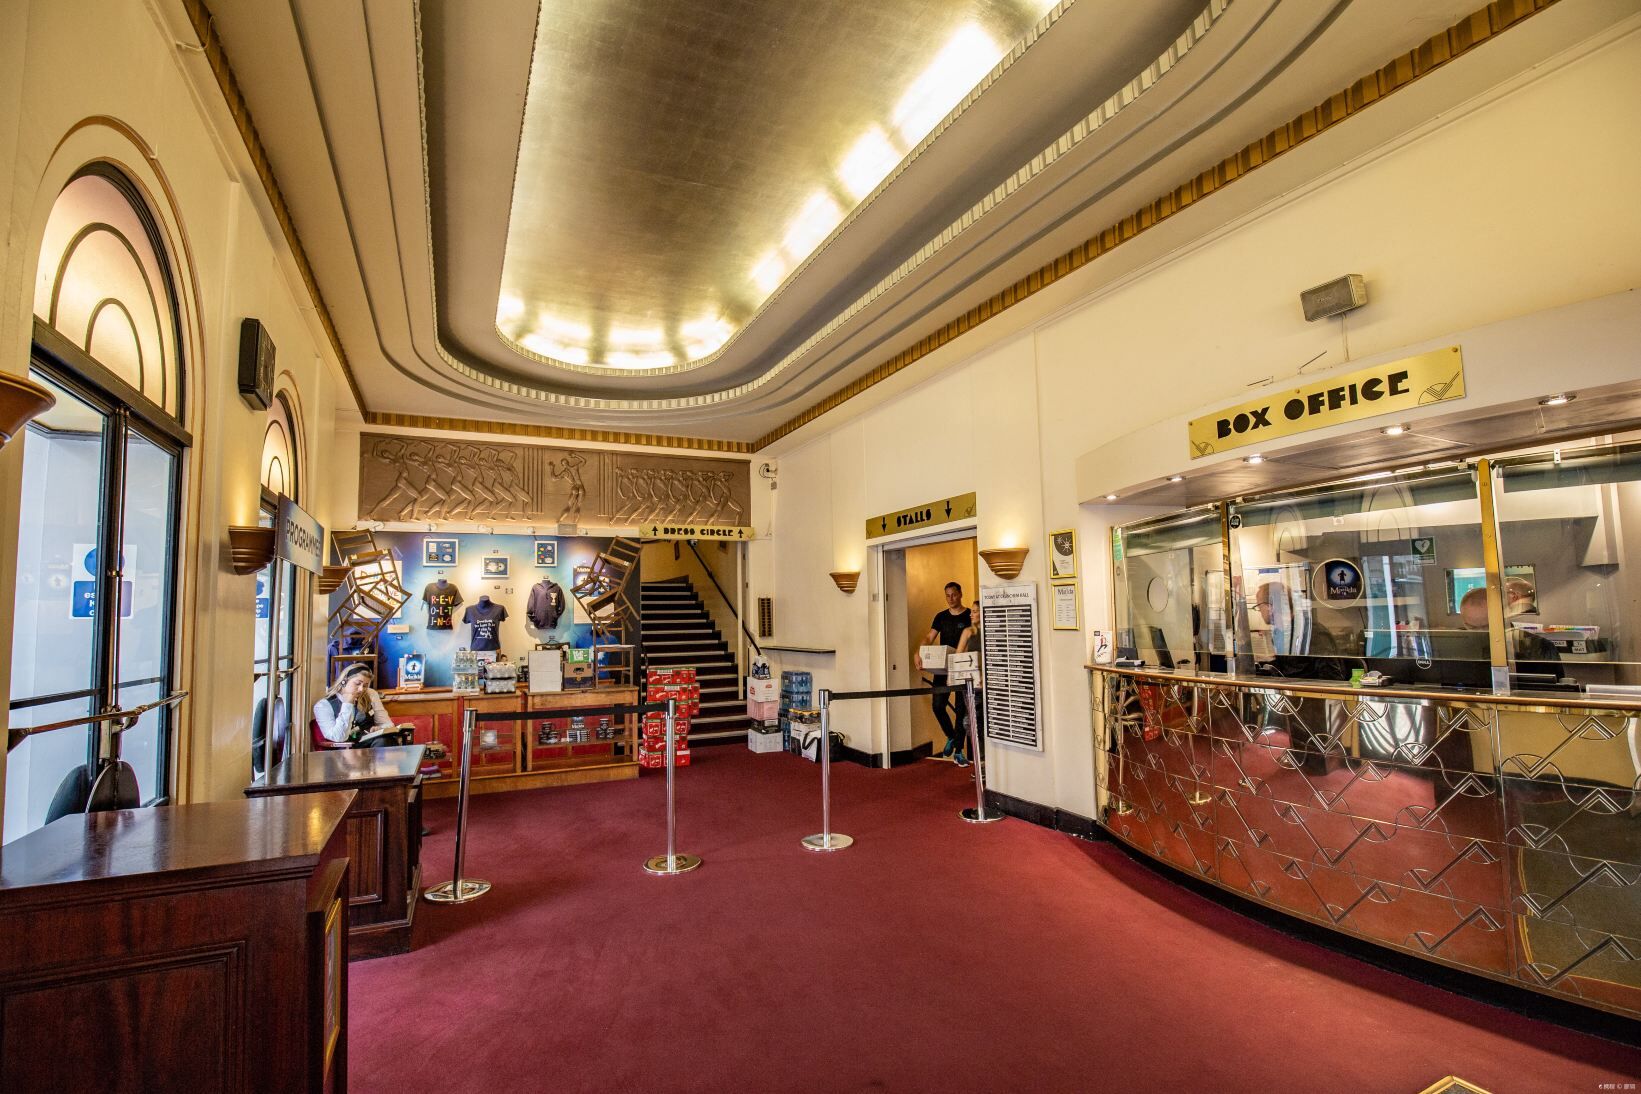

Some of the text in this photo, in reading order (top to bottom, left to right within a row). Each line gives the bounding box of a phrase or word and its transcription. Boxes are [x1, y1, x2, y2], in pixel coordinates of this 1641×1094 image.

[1217, 370, 1410, 439] BOX OFFICE
[896, 508, 932, 528] STALLS
[663, 527, 733, 537] DRESS CIRCLE
[431, 594, 454, 605] R-E-V
